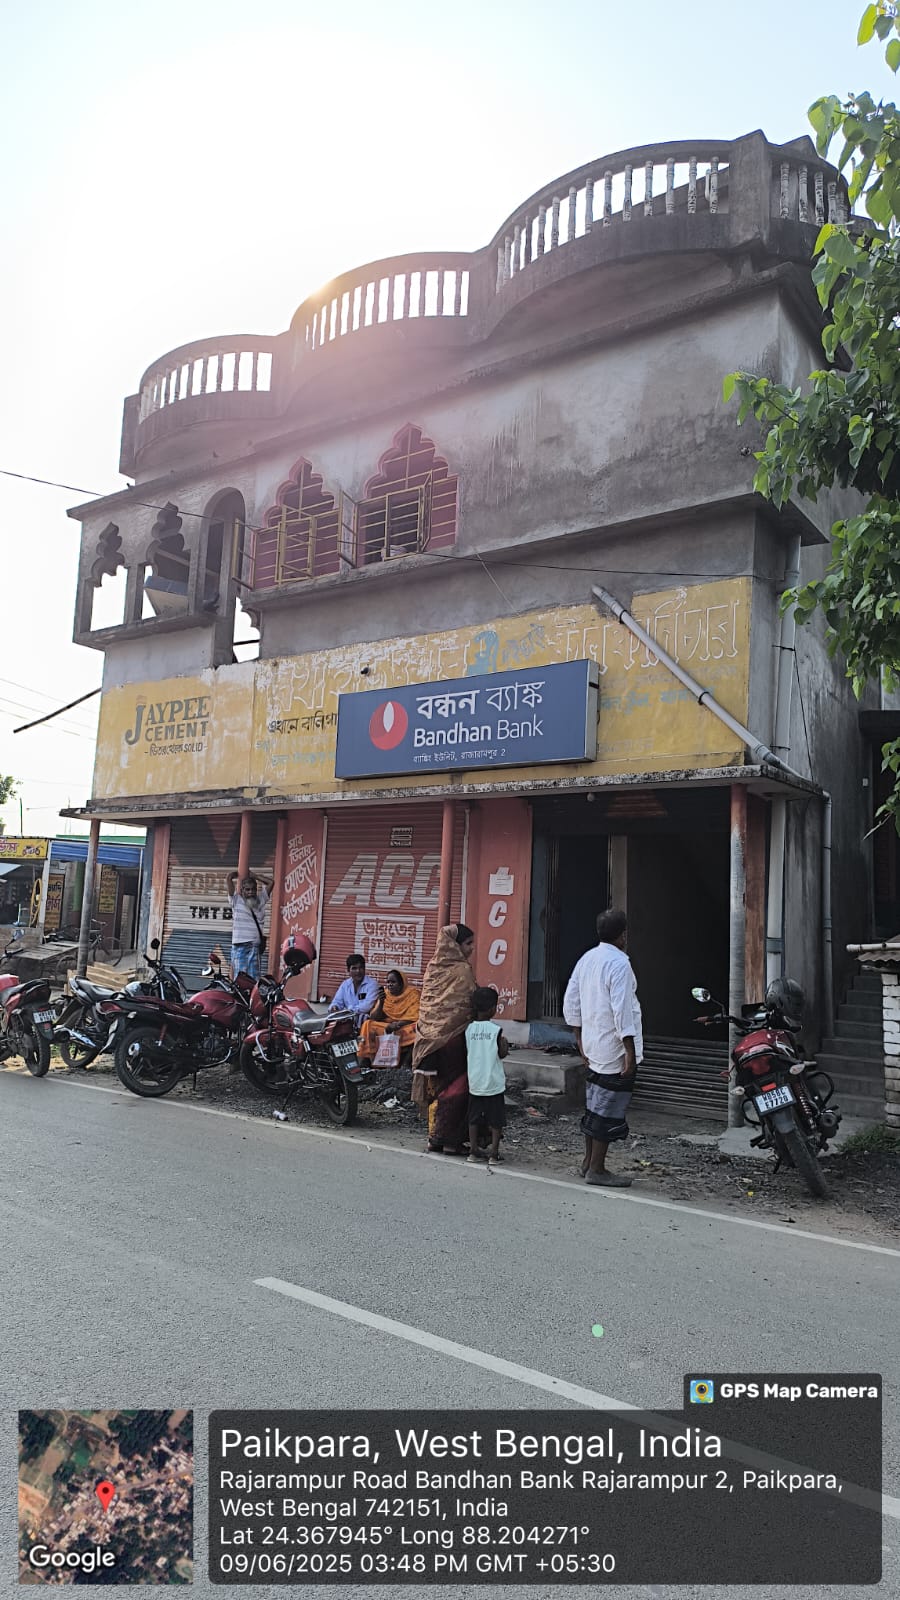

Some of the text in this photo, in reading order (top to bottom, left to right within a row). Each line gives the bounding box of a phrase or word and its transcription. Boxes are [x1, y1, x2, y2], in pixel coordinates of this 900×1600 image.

[416, 681, 546, 719] বন্ধন ব্যাঙ্ক
[125, 695, 211, 745] JAYPEE
[145, 720, 208, 742] CEMENT
[413, 713, 544, 747] Bandhan Bank
[500, 748, 506, 757] 2
[328, 852, 441, 909] ACC
[190, 906, 220, 920] TMT
